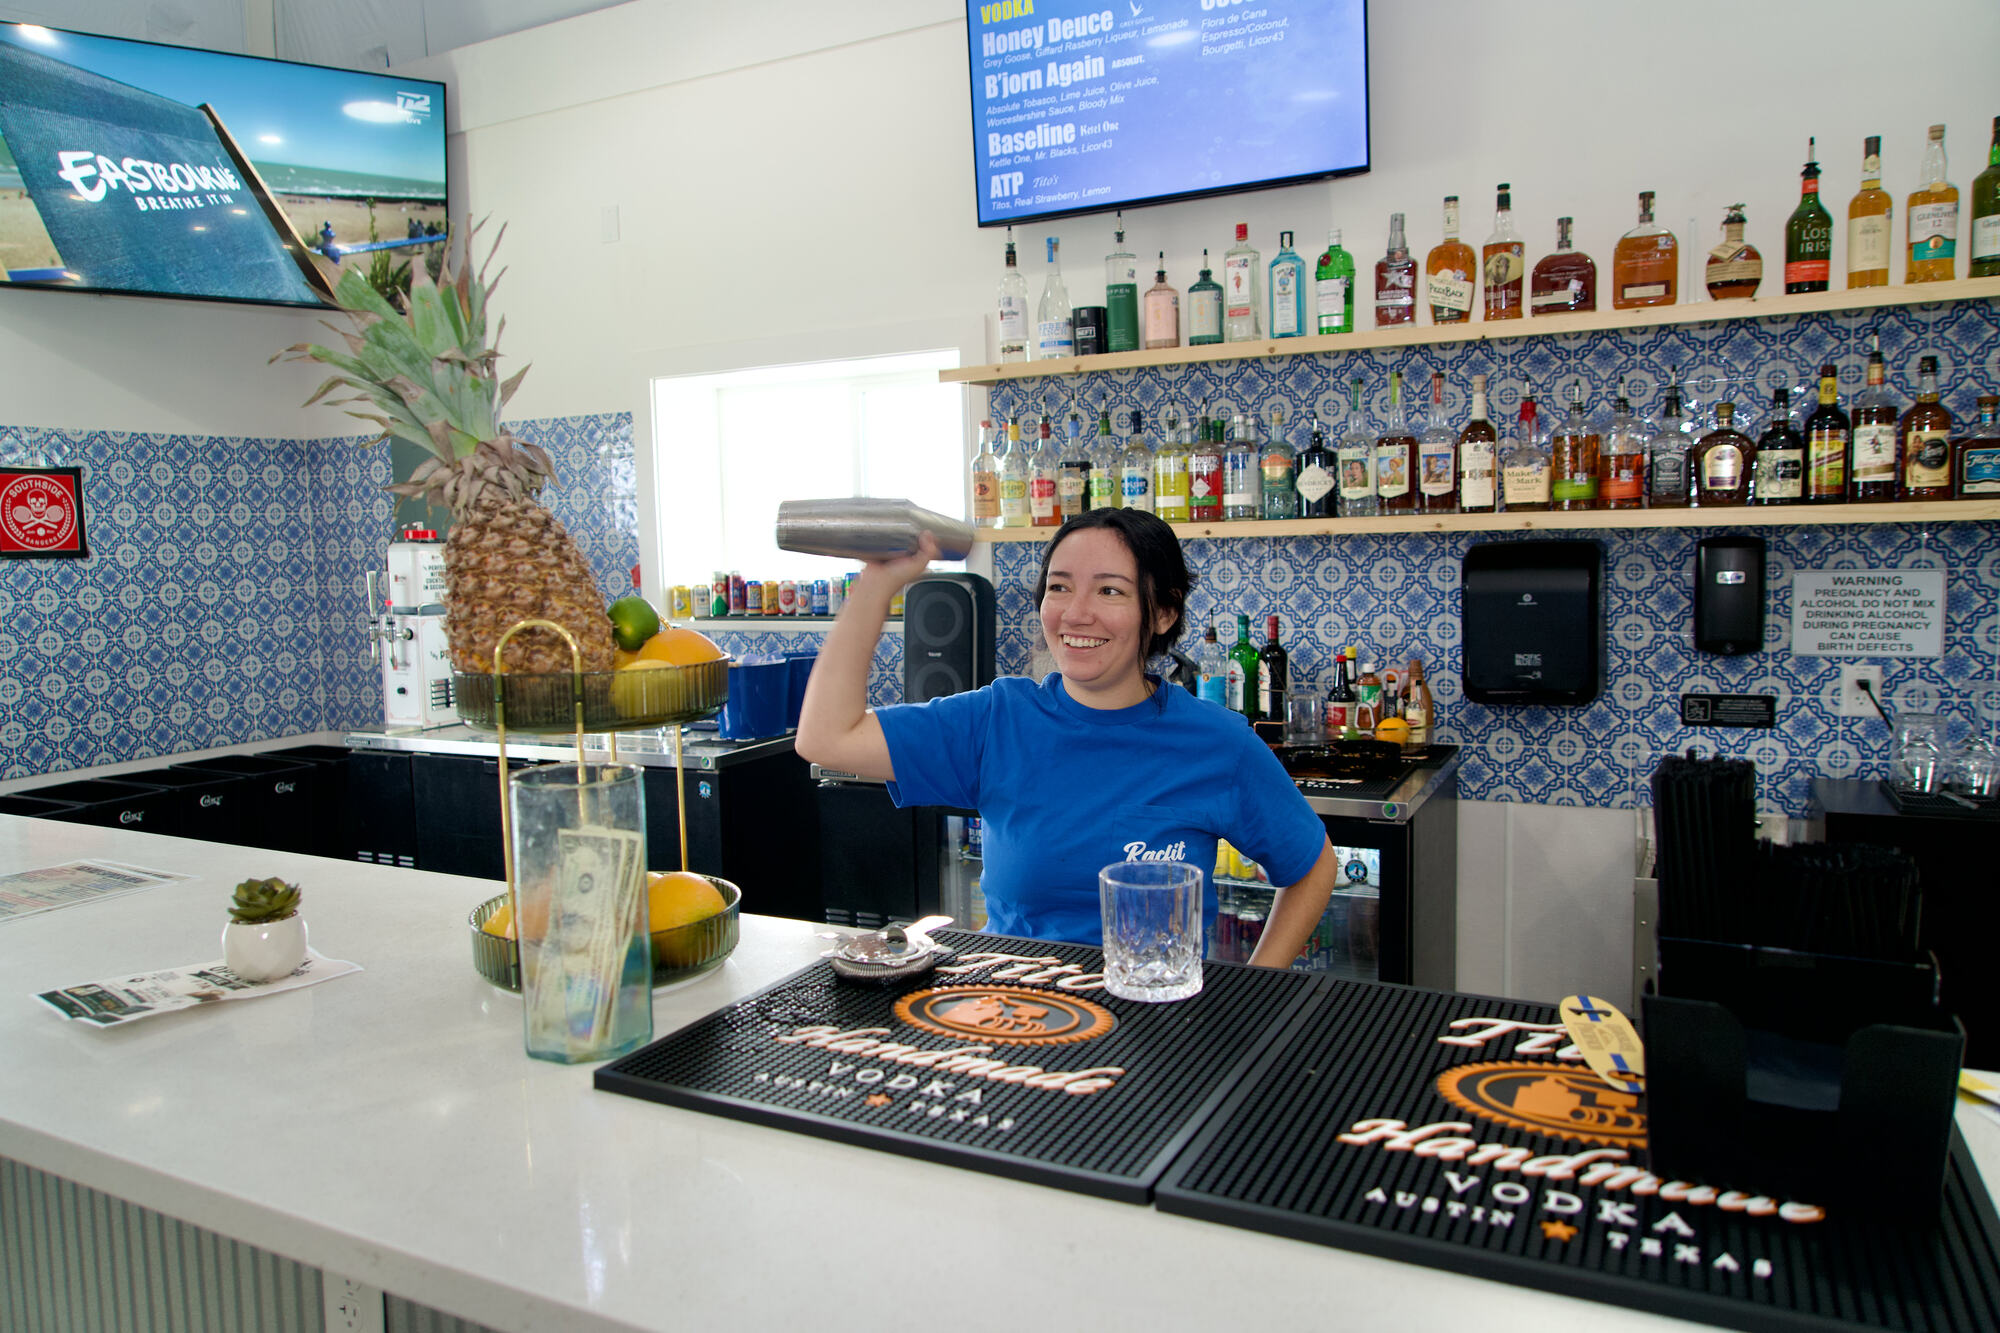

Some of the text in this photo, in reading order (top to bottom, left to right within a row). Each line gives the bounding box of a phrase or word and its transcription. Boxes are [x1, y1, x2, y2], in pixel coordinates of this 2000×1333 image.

[981, 0, 1034, 24] VODKA
[1227, 14, 1239, 24] de
[982, 10, 1114, 57] Honey Deuce
[984, 58, 1002, 69] Grey
[1141, 18, 1189, 36] Lemonade
[985, 55, 1105, 99] B'jorn Again
[986, 101, 1020, 116] Absolute
[1060, 90, 1080, 102] Lime
[1110, 80, 1132, 93] Olive
[987, 110, 1046, 128] Worcestershire
[1079, 99, 1108, 112] Bloody
[1110, 94, 1125, 106] Mix
[988, 122, 1076, 157] Baseline
[989, 157, 1011, 169] Kettle
[1081, 139, 1113, 153] Licor43
[58, 150, 241, 203] EASTBOURNE
[990, 171, 1024, 199] ATP
[1031, 174, 1060, 189] Tito's
[134, 193, 234, 212] BREATHE IT IN
[1014, 197, 1032, 208] Real
[1082, 185, 1112, 196] Lemon
[9, 480, 63, 498] SOUTHSIDE
[1814, 588, 1921, 598] PREGNANCY AND
[1832, 576, 1904, 586] WARNING
[1800, 599, 1936, 608] ALCOHOL DO NOT MIX
[1806, 610, 1928, 619] DRINKING ALCOHOL
[1802, 621, 1931, 630] DURING PREGNANCY
[1830, 632, 1902, 641] CAN CAUSE
[1817, 642, 1914, 652] BIRTH DEFECTS
[935, 952, 1104, 990] Tito
[774, 1025, 1127, 1095] Handmade
[828, 1061, 983, 1105] VODKA
[754, 1072, 1015, 1130] AUSTIN TEXAS
[1444, 1171, 1695, 1236] VODKA
[1364, 1187, 1773, 1277] AUSTIN TEXAS
